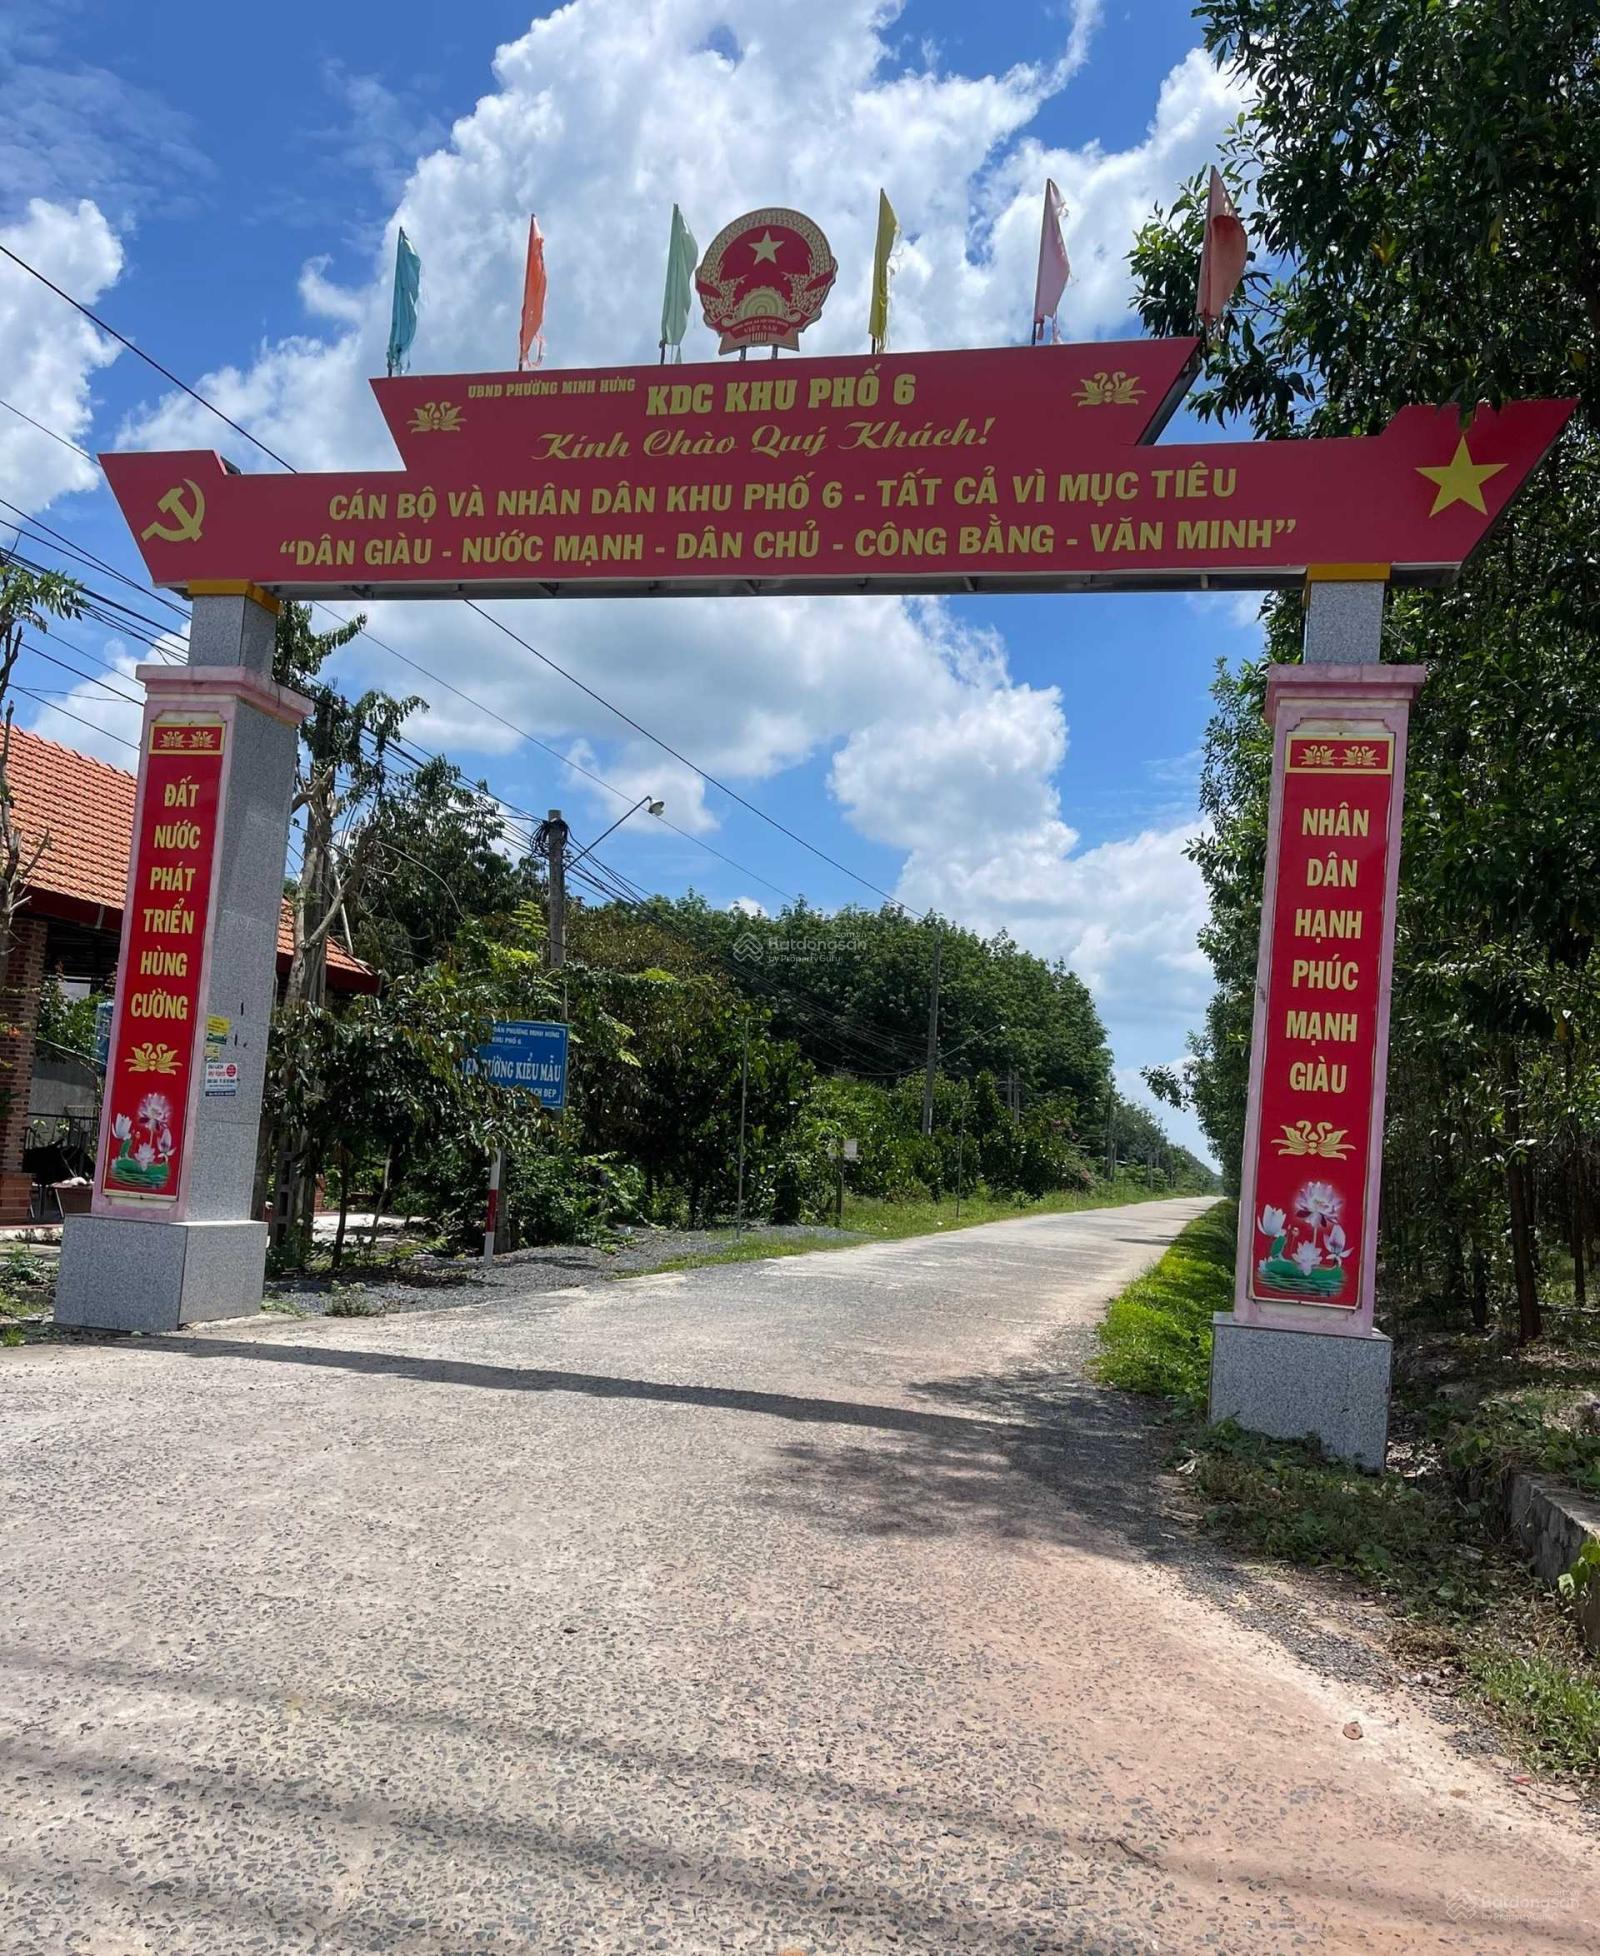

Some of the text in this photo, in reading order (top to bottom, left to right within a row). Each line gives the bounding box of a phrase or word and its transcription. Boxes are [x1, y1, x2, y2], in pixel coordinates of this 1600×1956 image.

[468, 376, 635, 398] UBND PHƯỜNG MINH HƯNG
[647, 364, 915, 415] KDC KHU PHỐ 6
[531, 418, 996, 460] Kính Chào Quý Khách!
[330, 489, 387, 520] CÁN
[397, 486, 436, 522] BỘ
[448, 486, 484, 517] VÀ
[497, 483, 580, 515] NHÂN
[592, 481, 655, 513] DÂN
[667, 485, 732, 512] KHU
[744, 472, 815, 510] PHỐ
[823, 482, 842, 508] 6
[877, 469, 942, 506] TẤT
[954, 466, 997, 504] CẢ
[1013, 469, 1045, 503] VÌ
[1059, 472, 1138, 506] MỤC
[1152, 462, 1236, 498] TIÊU
[365, 533, 431, 565] GIÀU
[463, 530, 543, 562] NƯỚC
[554, 534, 643, 565] MẠNH
[677, 526, 742, 559] DÂN
[754, 520, 819, 558] CHỦ
[855, 522, 946, 556] CÔNG
[959, 514, 1053, 553] BẰNG
[1091, 517, 1163, 552] VĂN
[165, 777, 199, 806] ĐẤT
[155, 821, 200, 848] NƯỚC
[1303, 802, 1369, 836] NHÂN
[150, 861, 195, 890] PHÁT
[1307, 852, 1357, 887] DÂN
[144, 899, 194, 934] TRIỂN
[1295, 909, 1362, 942] HẠNH
[141, 946, 187, 976] HÙNG
[1293, 955, 1358, 990] PHÚC
[131, 987, 188, 1019] CƯỜNG
[1286, 1011, 1357, 1046] MẠNH
[515, 1052, 539, 1081] KIỂU
[540, 1054, 561, 1082] MẪU
[1290, 1056, 1346, 1093] GIÀU
